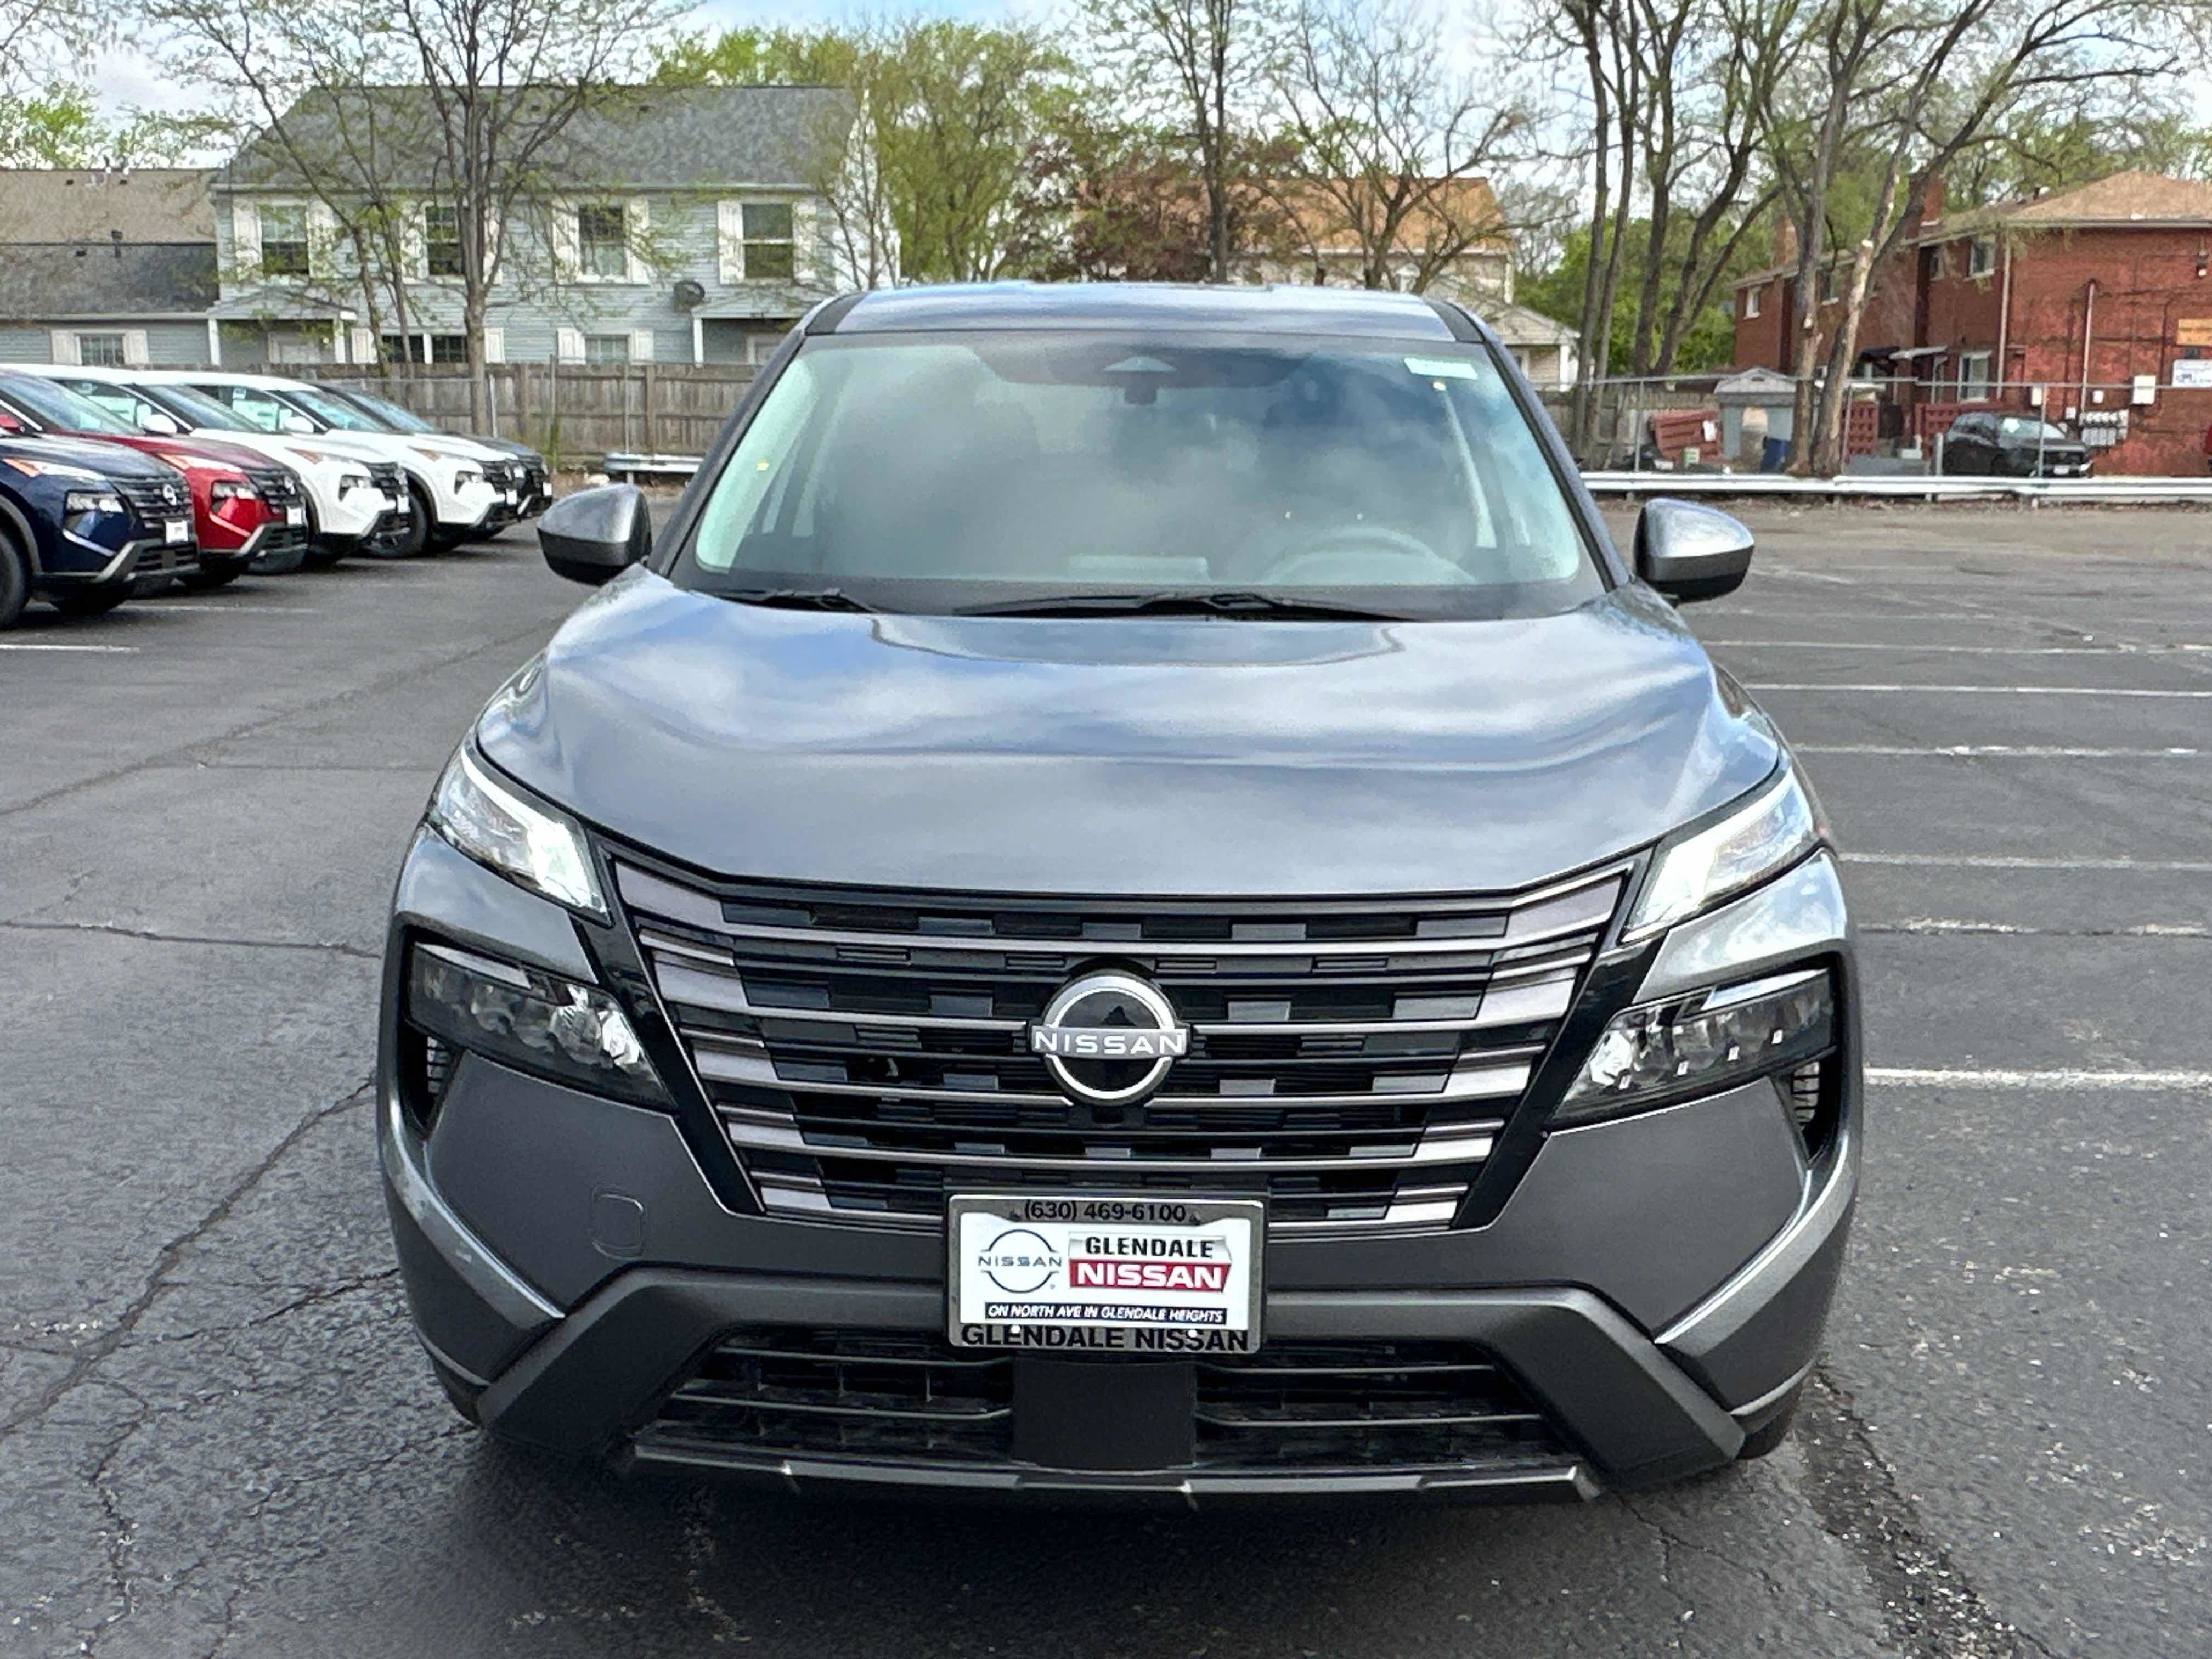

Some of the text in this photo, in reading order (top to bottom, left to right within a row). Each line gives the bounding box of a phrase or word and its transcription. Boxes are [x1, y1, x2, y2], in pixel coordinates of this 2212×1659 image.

[1034, 1031, 1184, 1054] NISSAN
[1025, 1199, 1186, 1221] (630) 469-6100
[1085, 1237, 1214, 1259] GLENDALE
[978, 1256, 1062, 1267] NISSAN
[1077, 1262, 1222, 1289] NISSAN
[988, 1305, 1223, 1322] ON NORTH AVE IN GLENDALE HEIGHTS
[962, 1323, 1249, 1351] GLENDALE NISSAN
